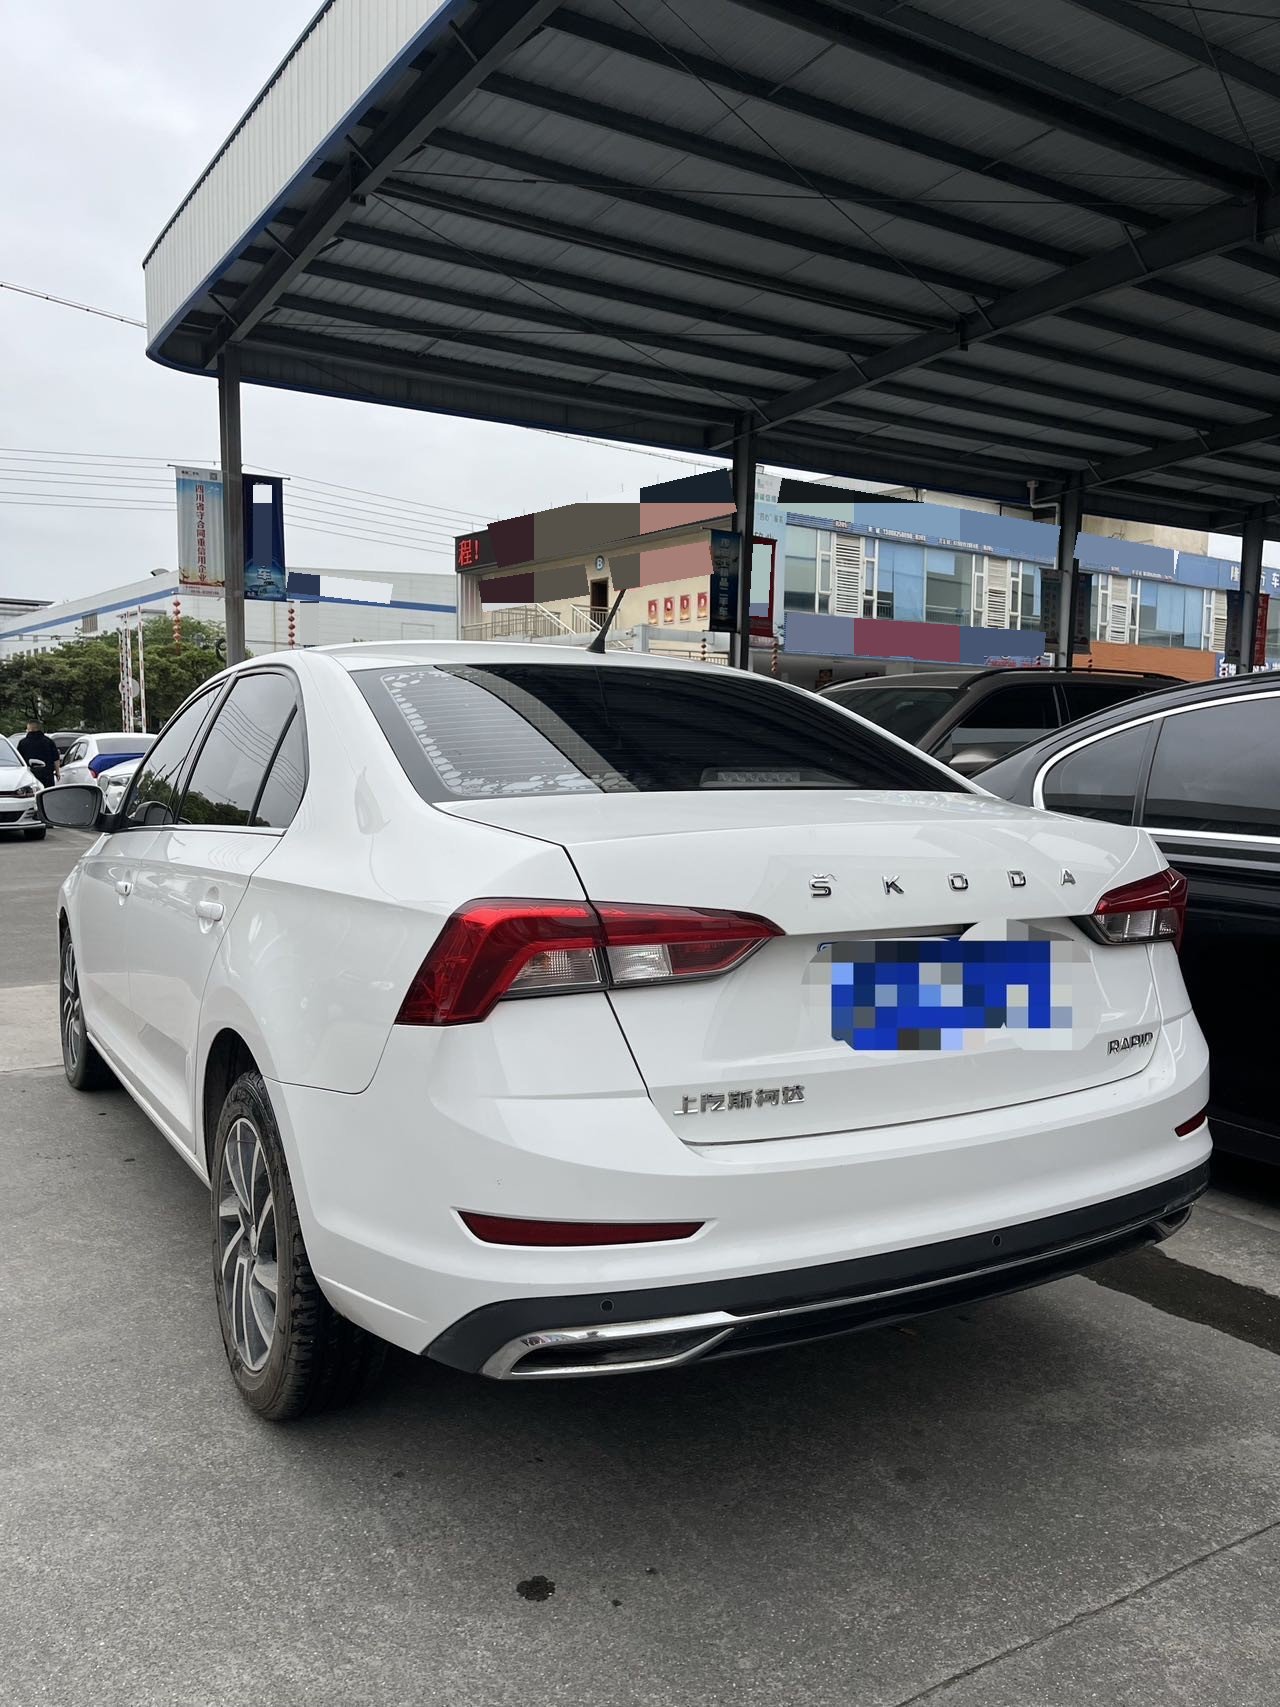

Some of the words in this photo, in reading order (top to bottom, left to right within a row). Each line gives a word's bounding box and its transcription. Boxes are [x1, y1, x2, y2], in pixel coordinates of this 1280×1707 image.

[195, 484, 208, 582] 四川省守合同重信用企业
[1107, 1032, 1154, 1055] RAPID
[673, 1085, 805, 1115] 上汽斯柯达
